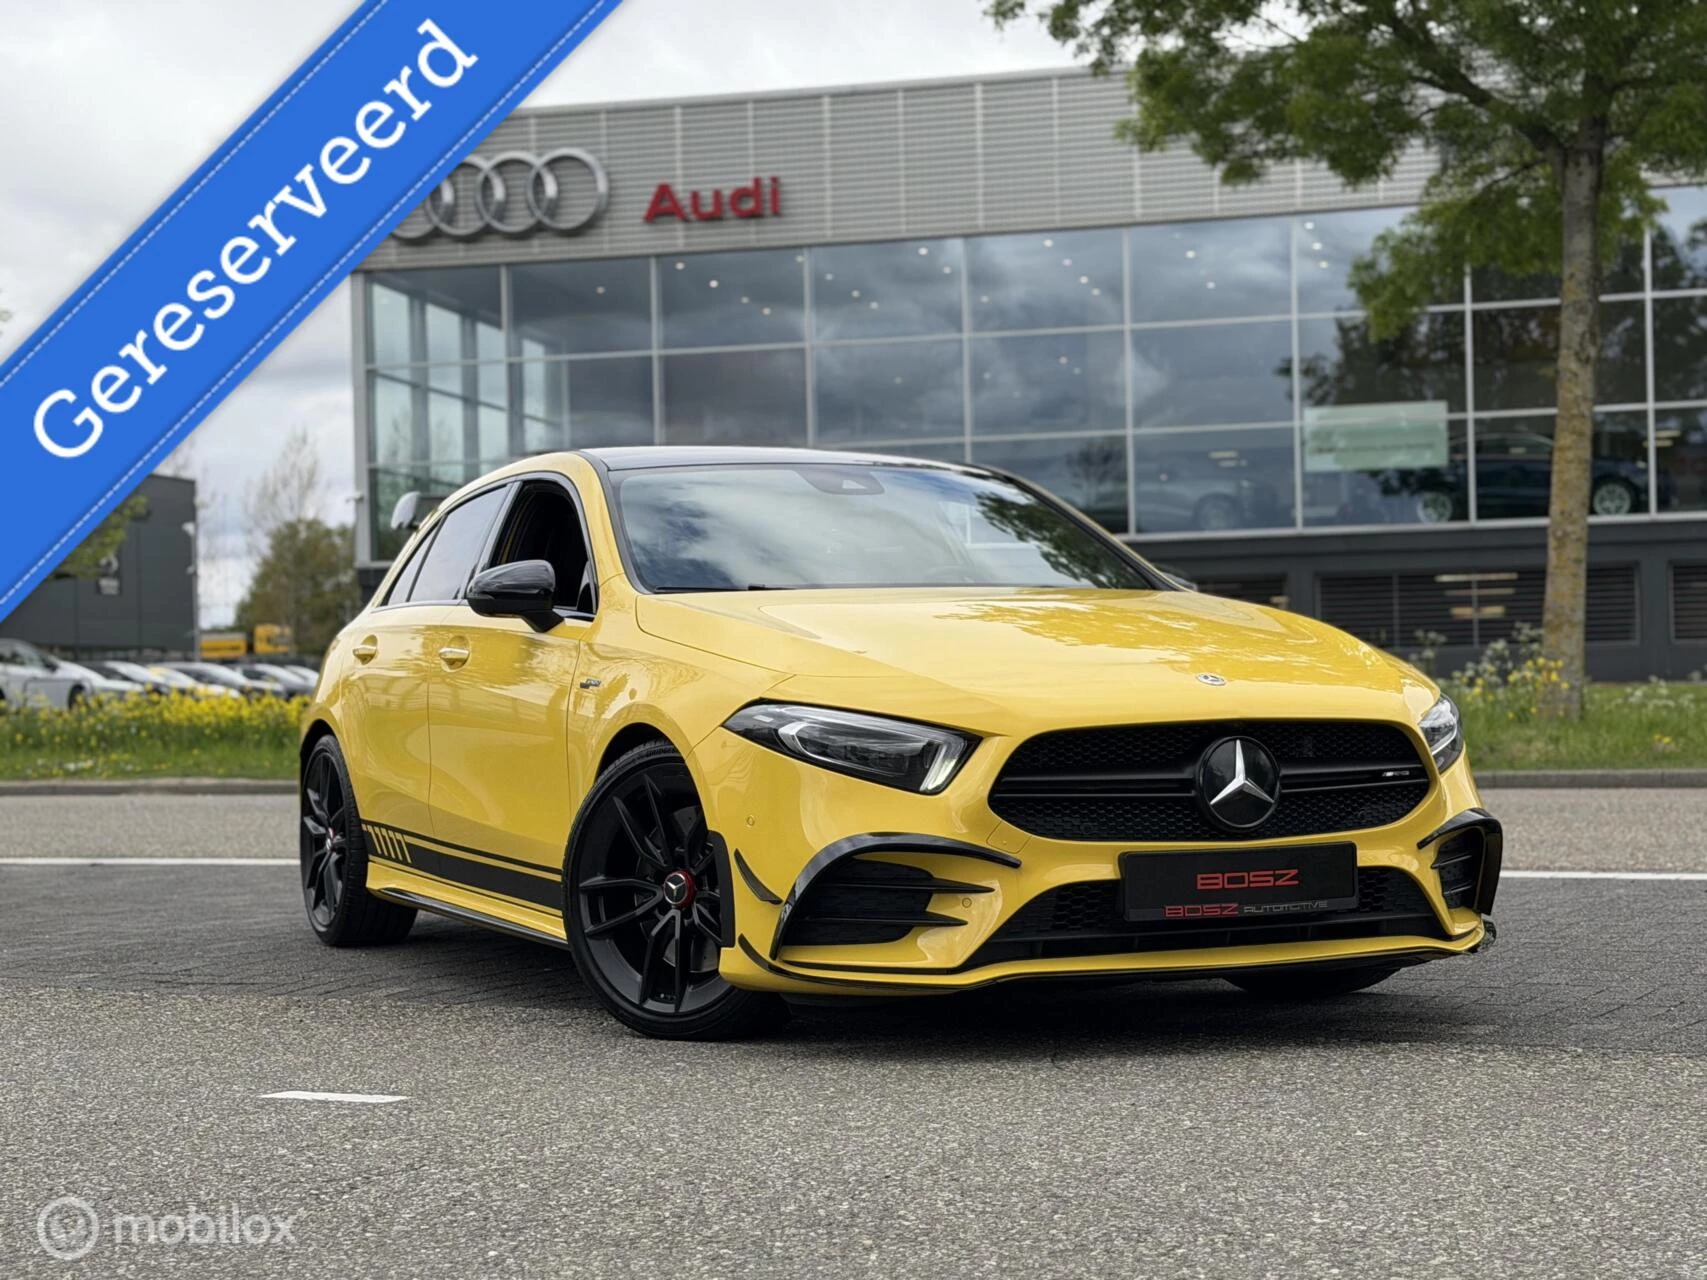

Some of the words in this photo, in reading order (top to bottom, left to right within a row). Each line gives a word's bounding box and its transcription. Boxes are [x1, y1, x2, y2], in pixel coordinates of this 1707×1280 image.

[642, 176, 782, 224] Audi
[1196, 869, 1299, 890] BOSZ
[1164, 903, 1239, 918] BOSZ
[1243, 900, 1328, 913] AUTOMOTIVE
